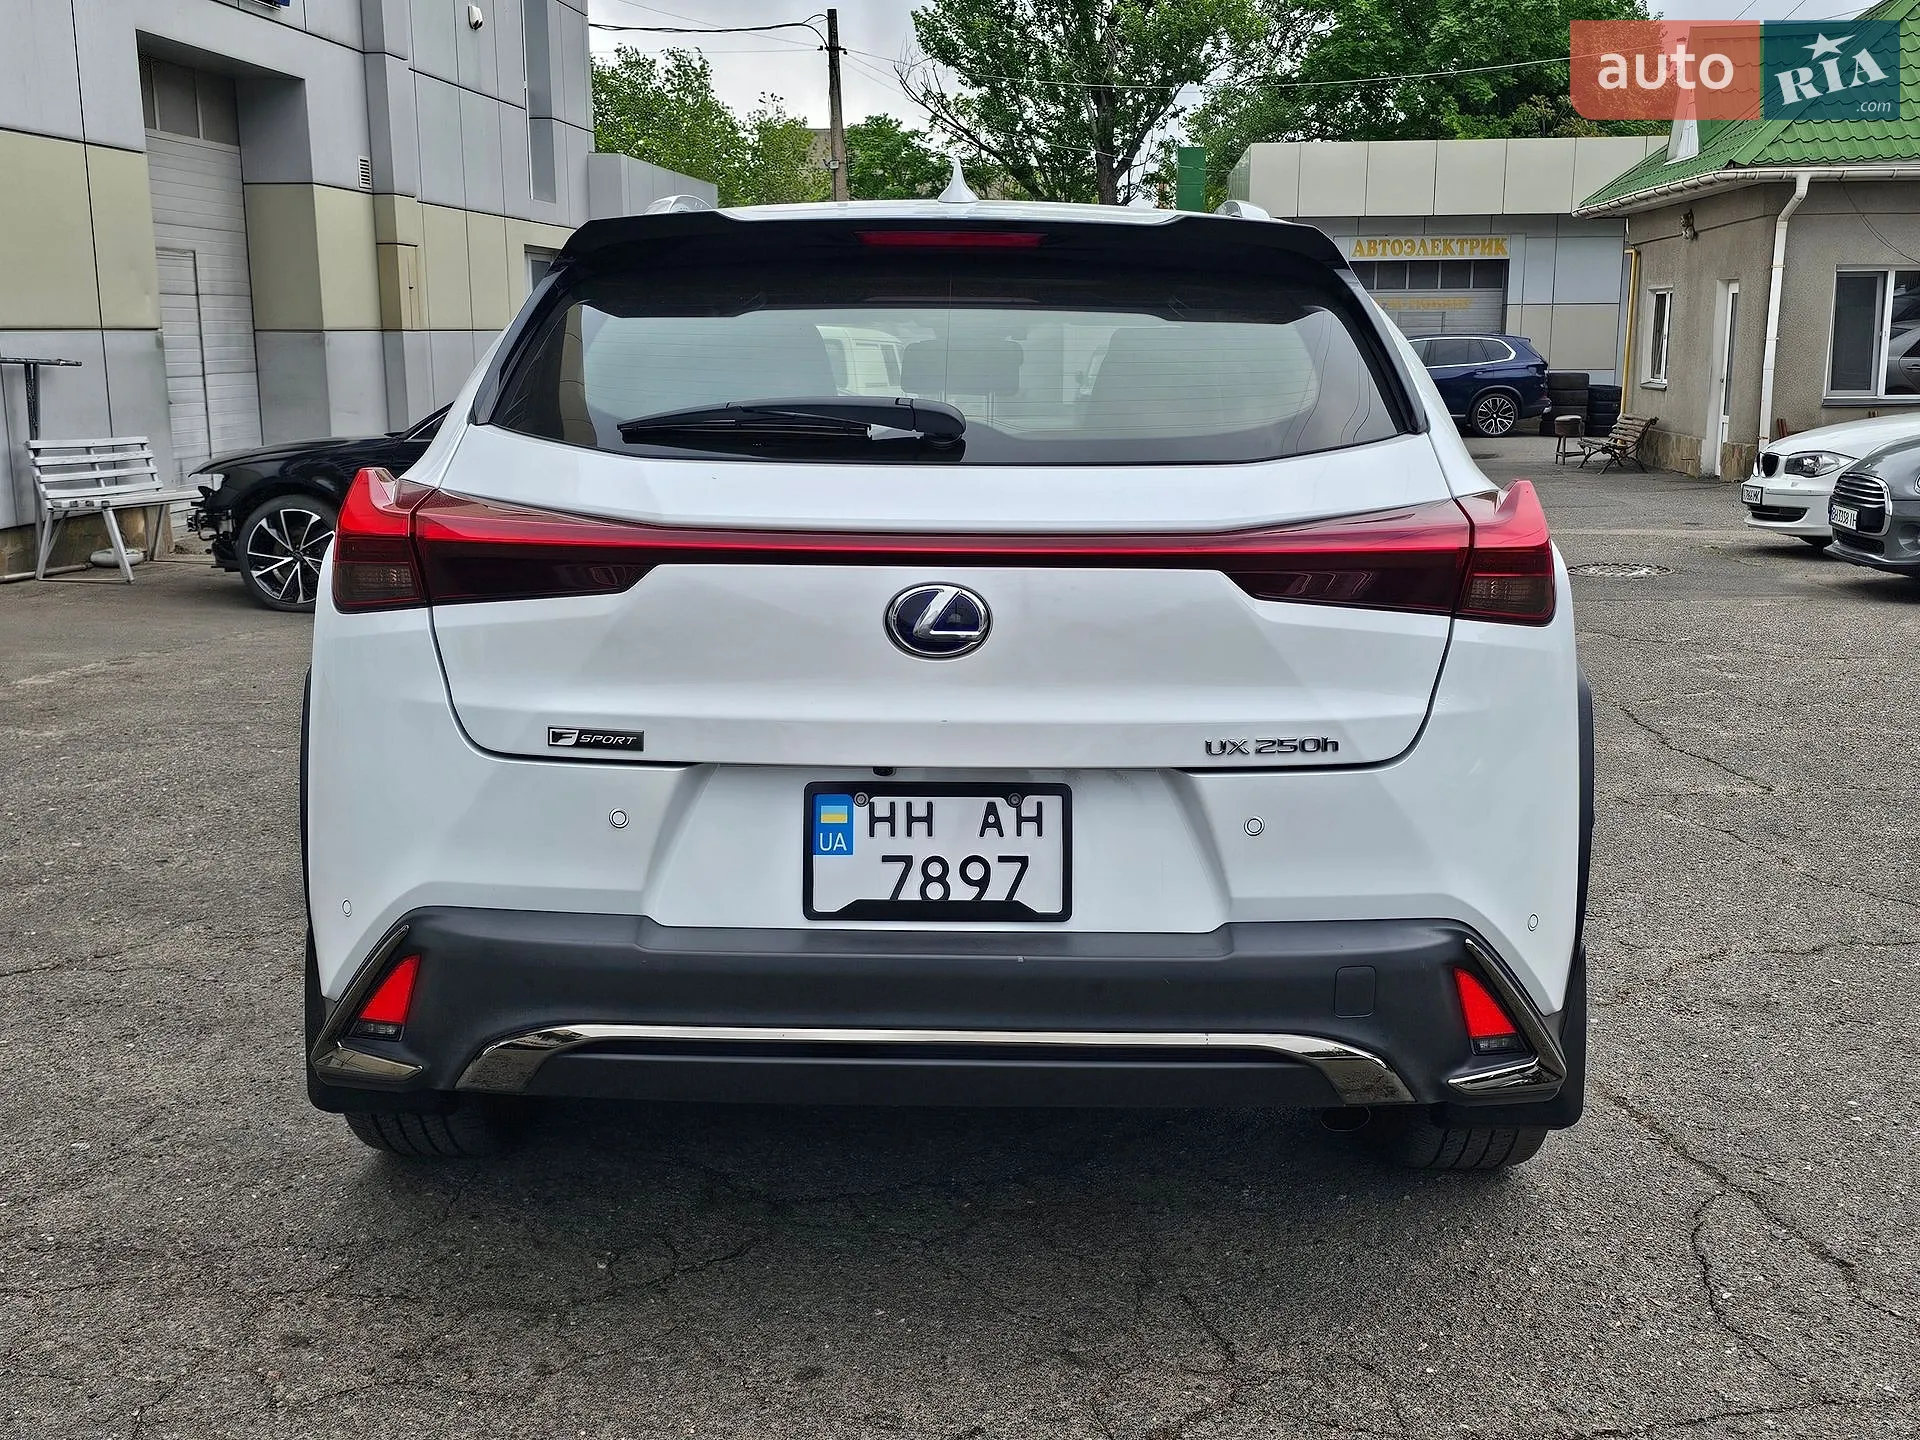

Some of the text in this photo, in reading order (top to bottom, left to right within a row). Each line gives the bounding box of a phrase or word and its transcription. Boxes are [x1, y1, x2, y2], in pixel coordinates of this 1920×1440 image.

[1352, 237, 1508, 257] АВТОЭЛЕКТРИК
[580, 734, 637, 745] SPORT
[1205, 736, 1339, 756] UX 250h
[868, 801, 1043, 838] HH AH
[819, 832, 847, 851] UA
[881, 854, 1029, 901] 7897
